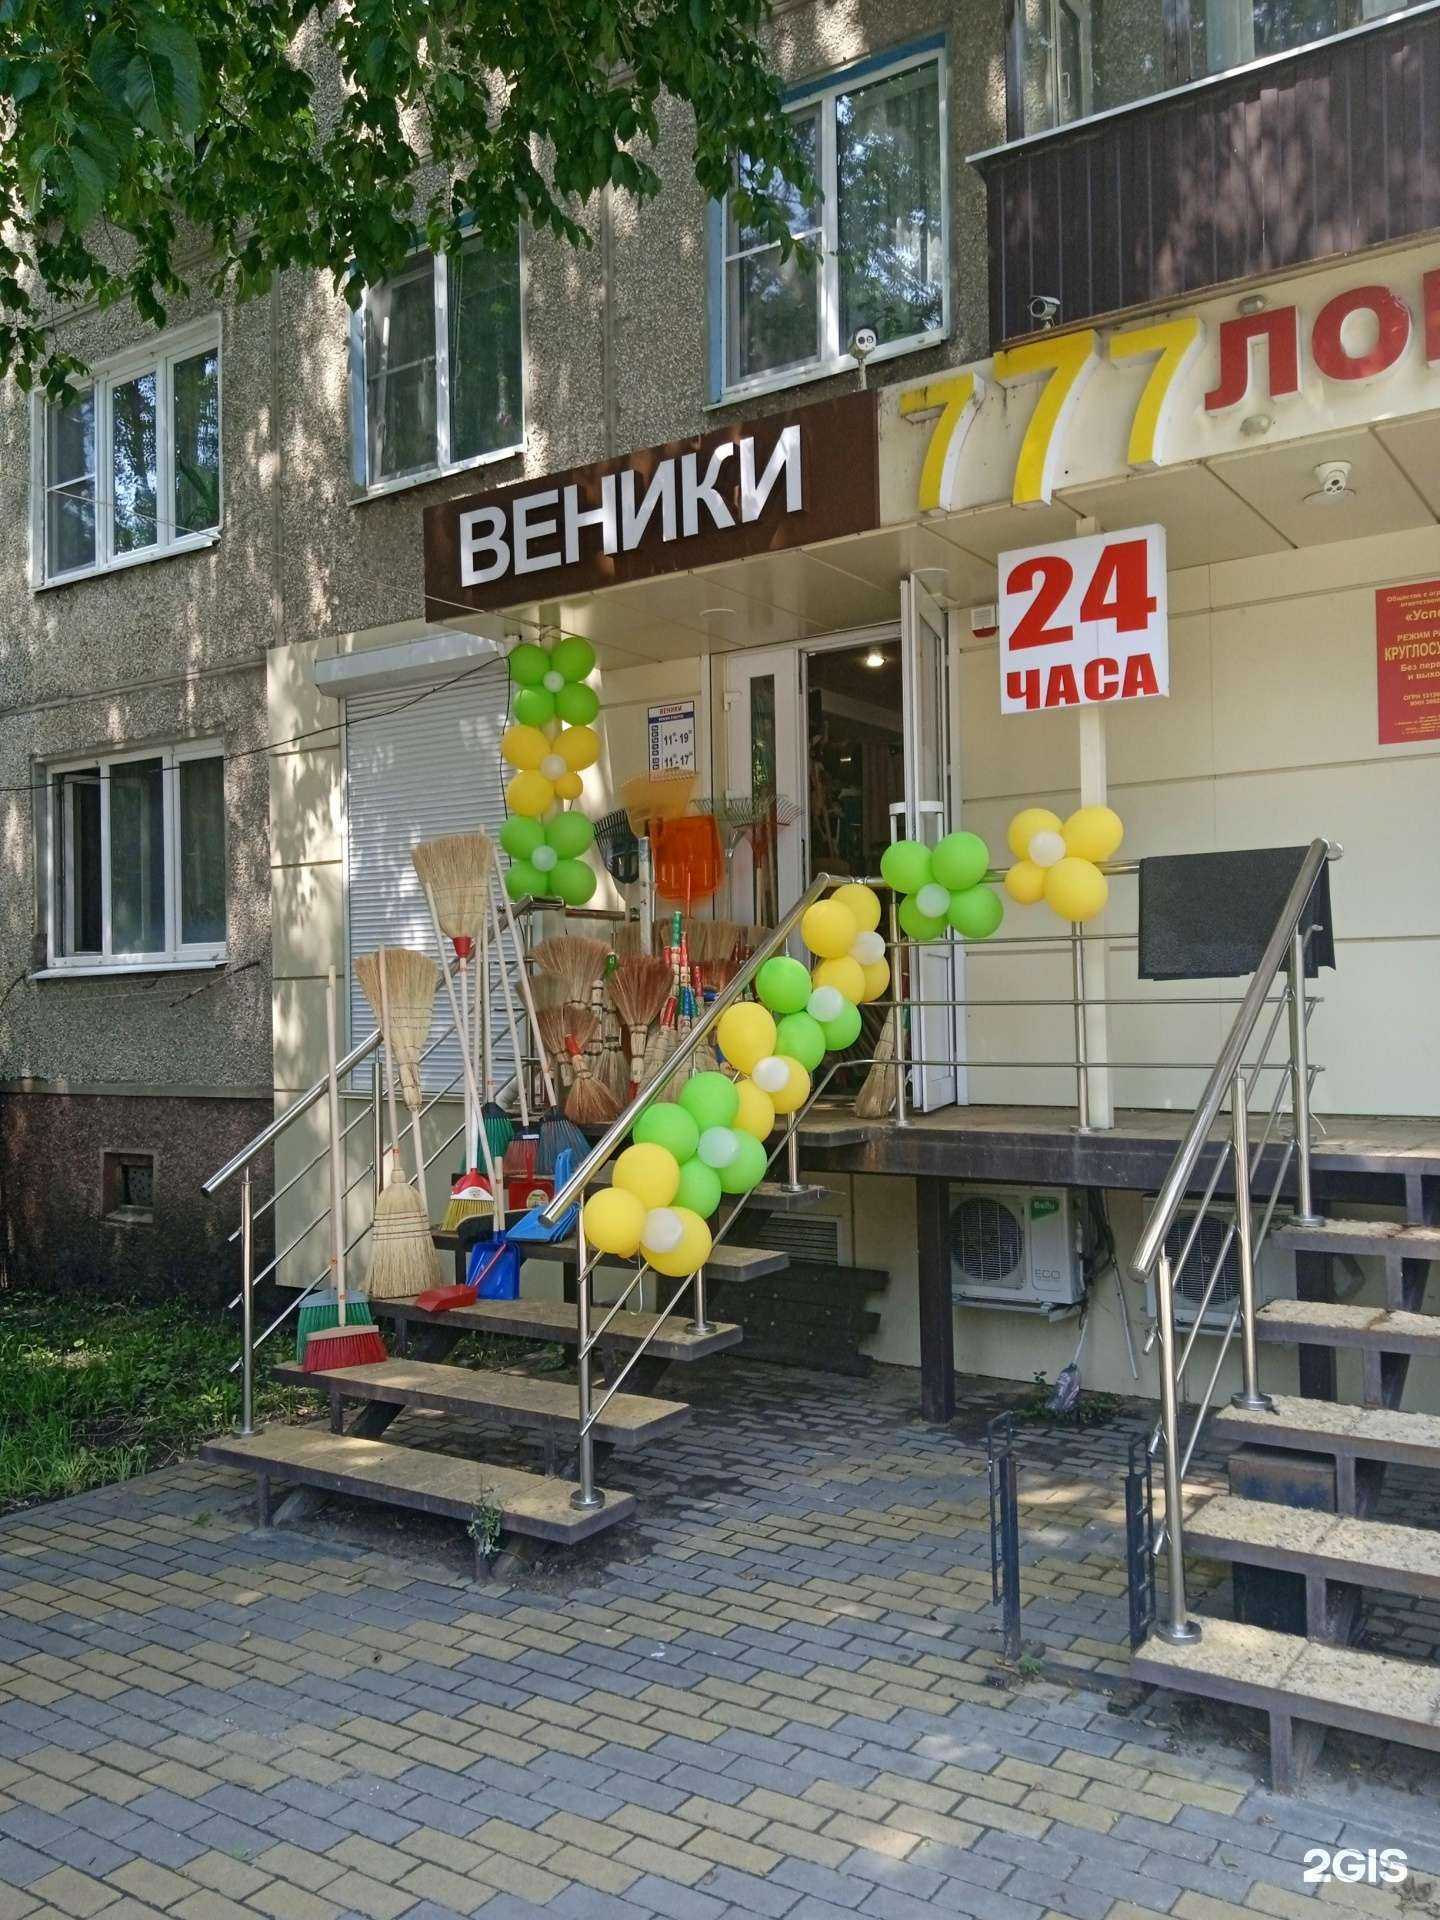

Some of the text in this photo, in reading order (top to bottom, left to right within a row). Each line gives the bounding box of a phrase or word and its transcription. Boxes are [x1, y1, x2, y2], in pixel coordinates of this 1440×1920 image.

[899, 317, 1203, 511] 777
[459, 424, 803, 588] ВЕНИКИ
[1006, 539, 1157, 651] 24
[1006, 653, 1159, 710] ЧАСА
